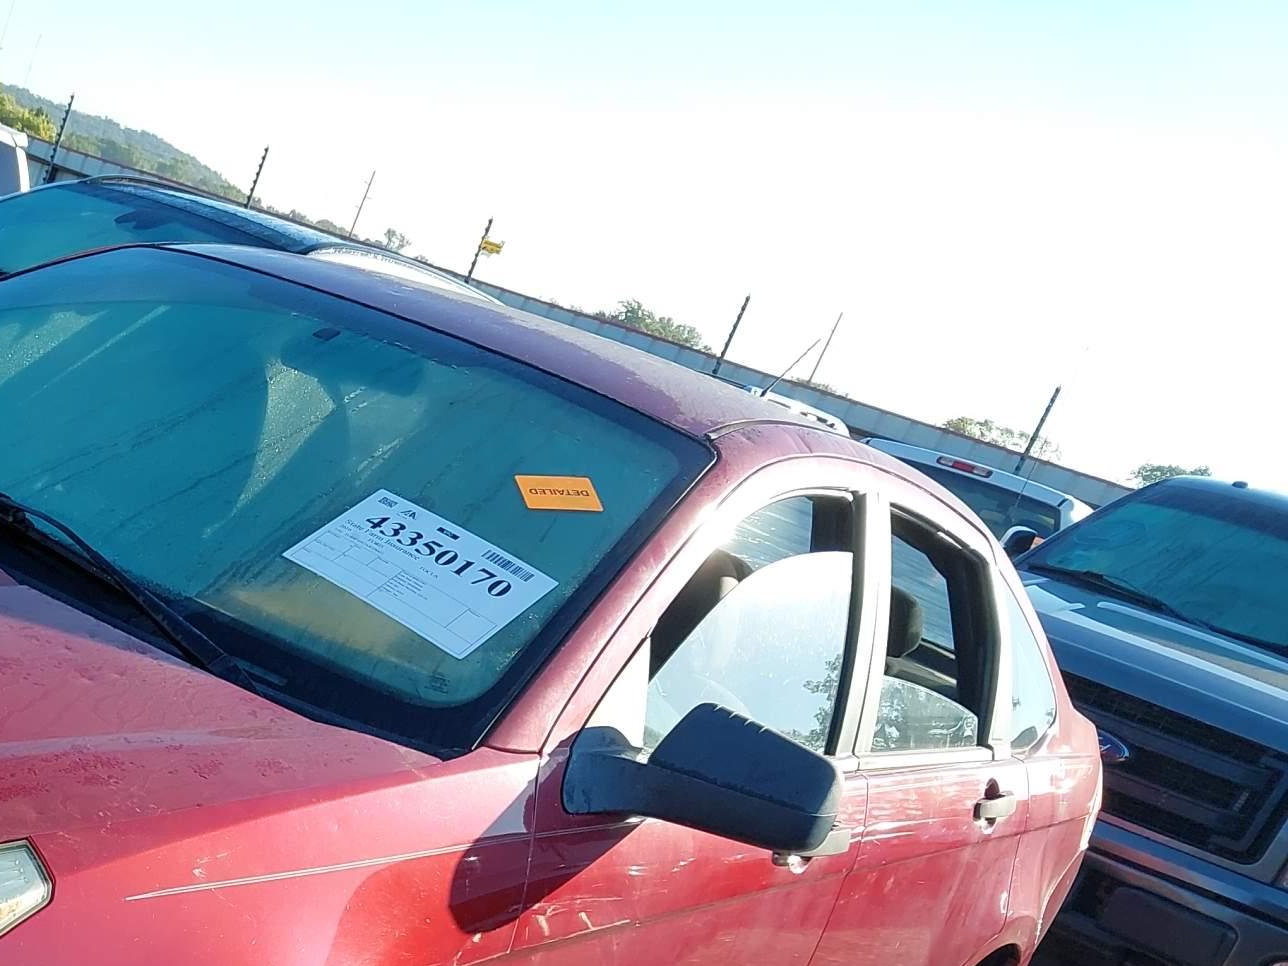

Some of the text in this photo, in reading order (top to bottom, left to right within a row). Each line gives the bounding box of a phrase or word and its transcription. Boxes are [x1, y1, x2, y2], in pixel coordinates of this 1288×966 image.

[528, 487, 590, 497] DETAILED
[365, 516, 513, 598] 43350170
[383, 539, 421, 561] Insurance
